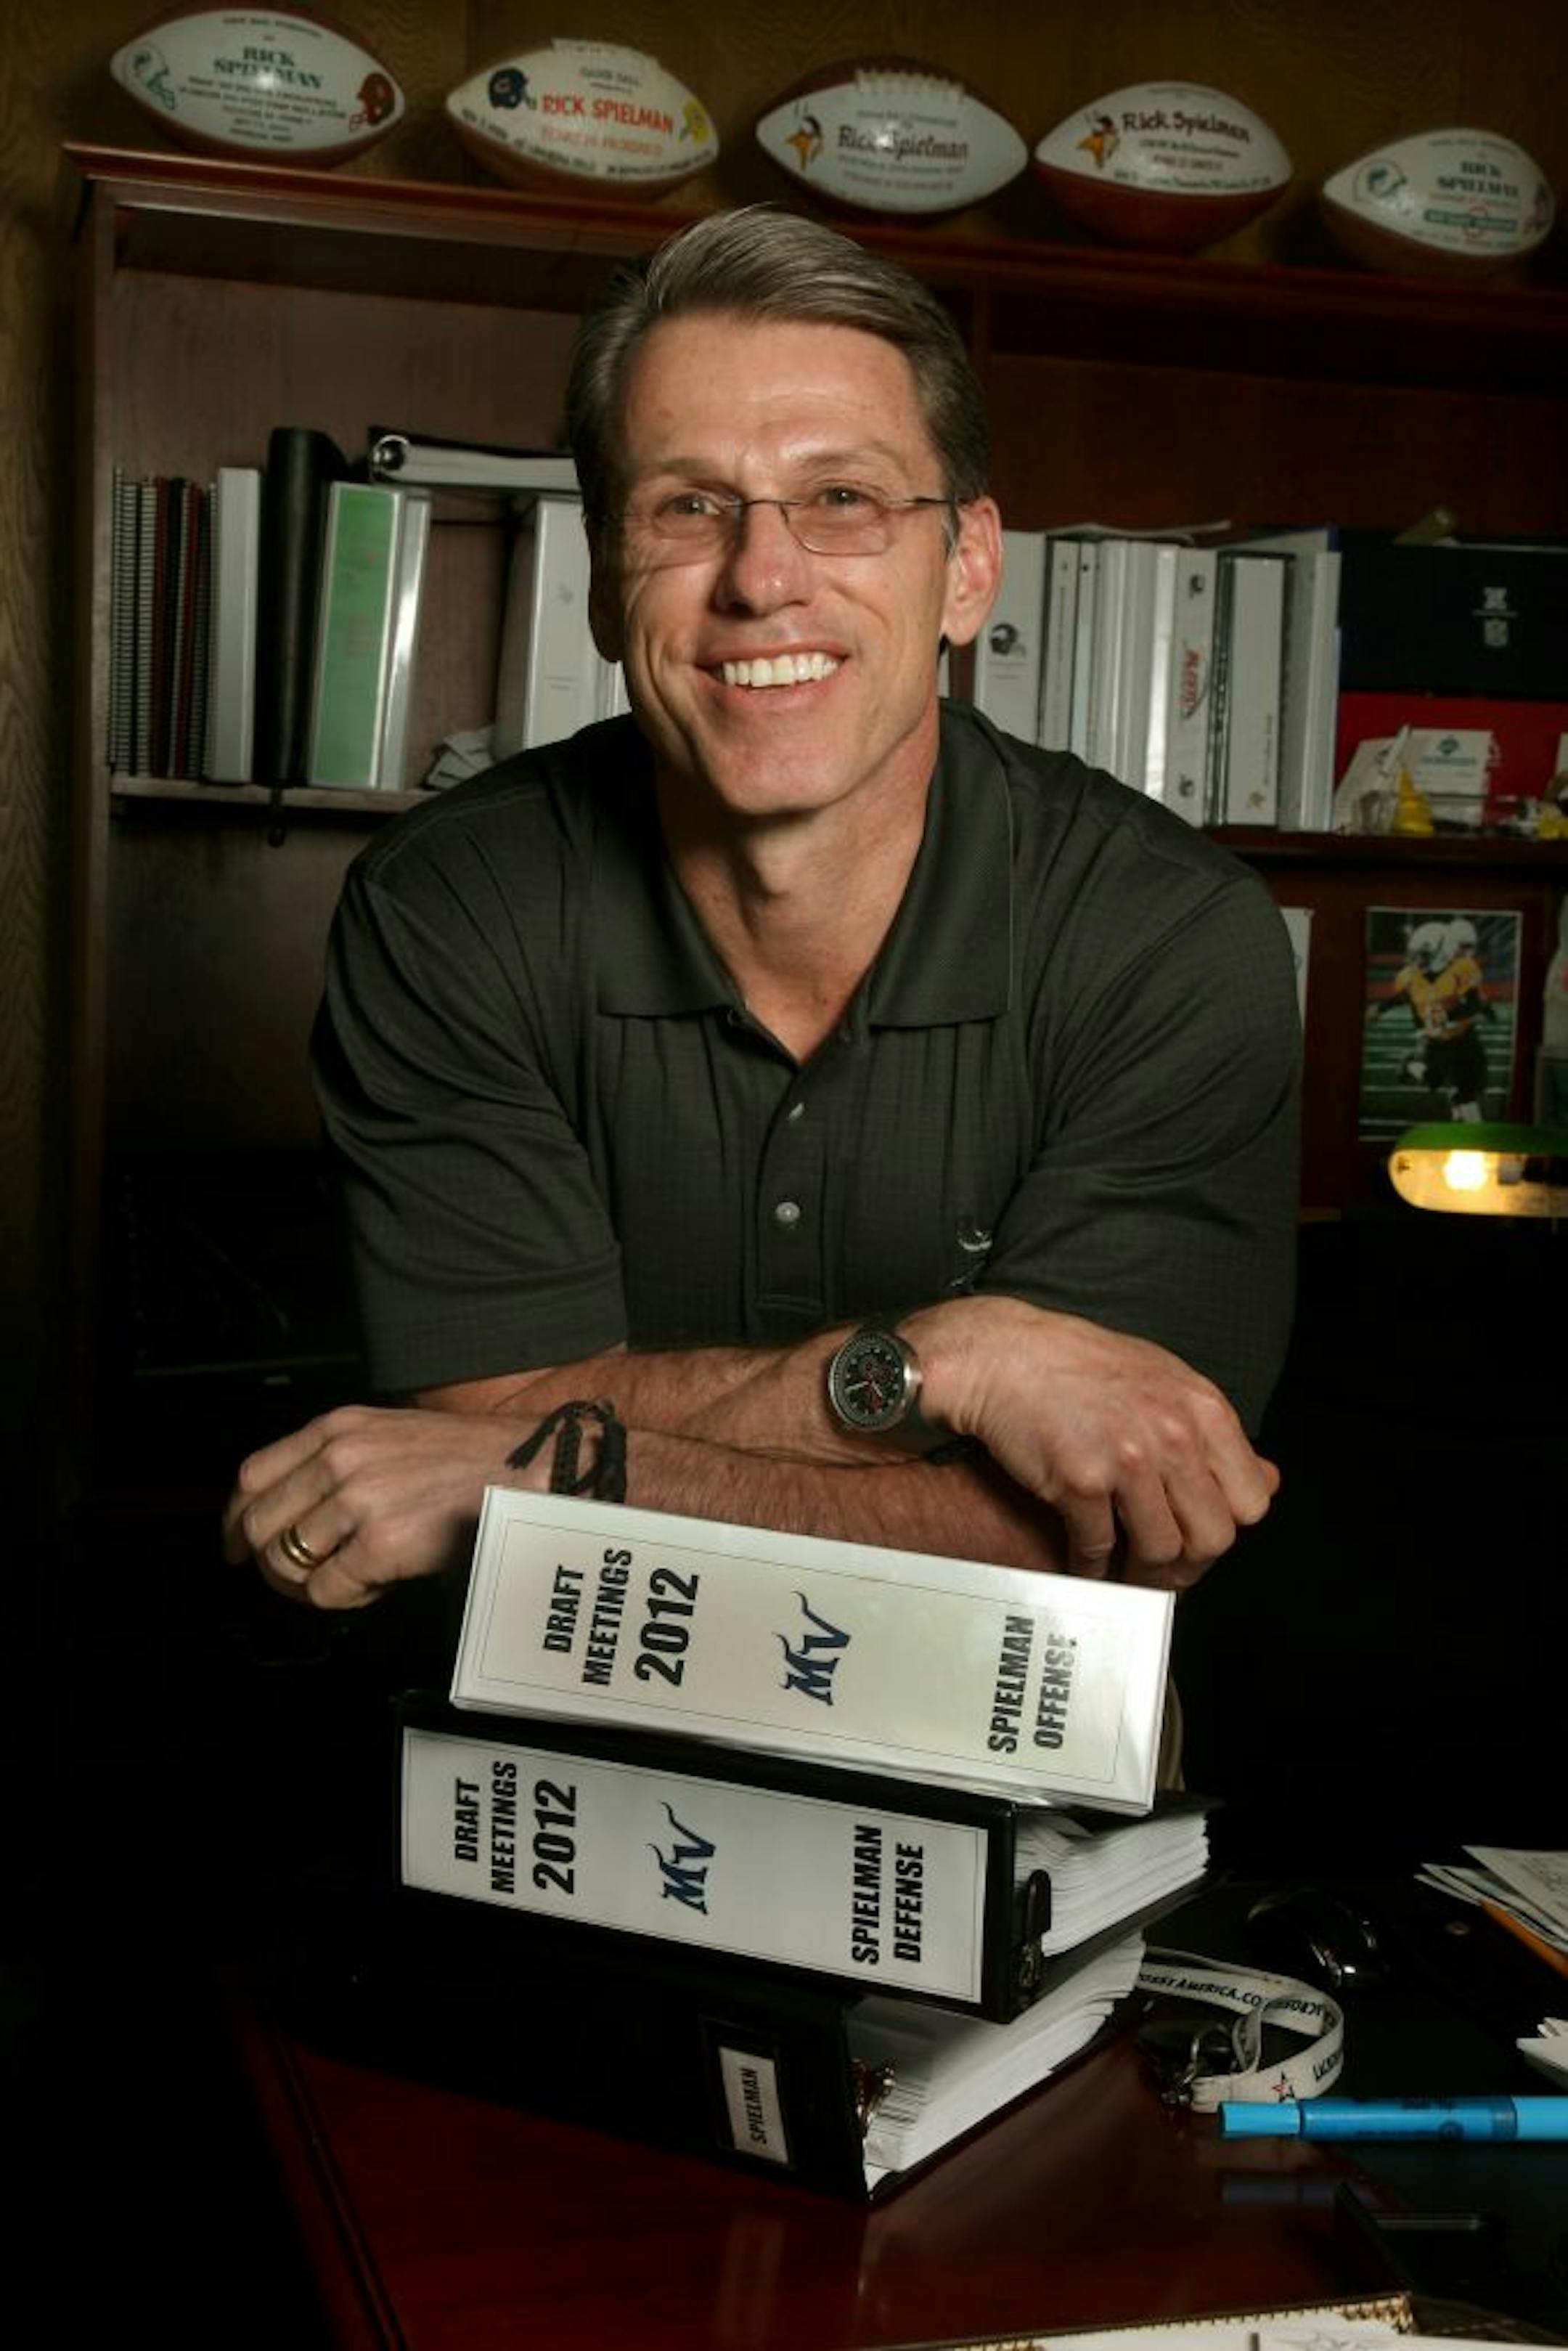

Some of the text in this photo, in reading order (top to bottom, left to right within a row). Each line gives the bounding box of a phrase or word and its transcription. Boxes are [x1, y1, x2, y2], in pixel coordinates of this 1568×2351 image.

[542, 94, 674, 134] RICK SPIELMAN
[1122, 109, 1250, 144] Rick Spielman
[543, 1565, 584, 1653] DRAFT
[583, 1549, 632, 1686] MEETINGS
[634, 1568, 699, 1686] 2012
[987, 1615, 1034, 1753] SPIELMAN
[454, 1777, 480, 1862] DRAFT
[491, 1761, 517, 1894] MEETINGS
[533, 1779, 576, 1894] 2012
[852, 1825, 882, 1965] SPIELMAN
[894, 1843, 923, 1963] DEFENSE
[740, 2068, 765, 2143] SPIELMAN
